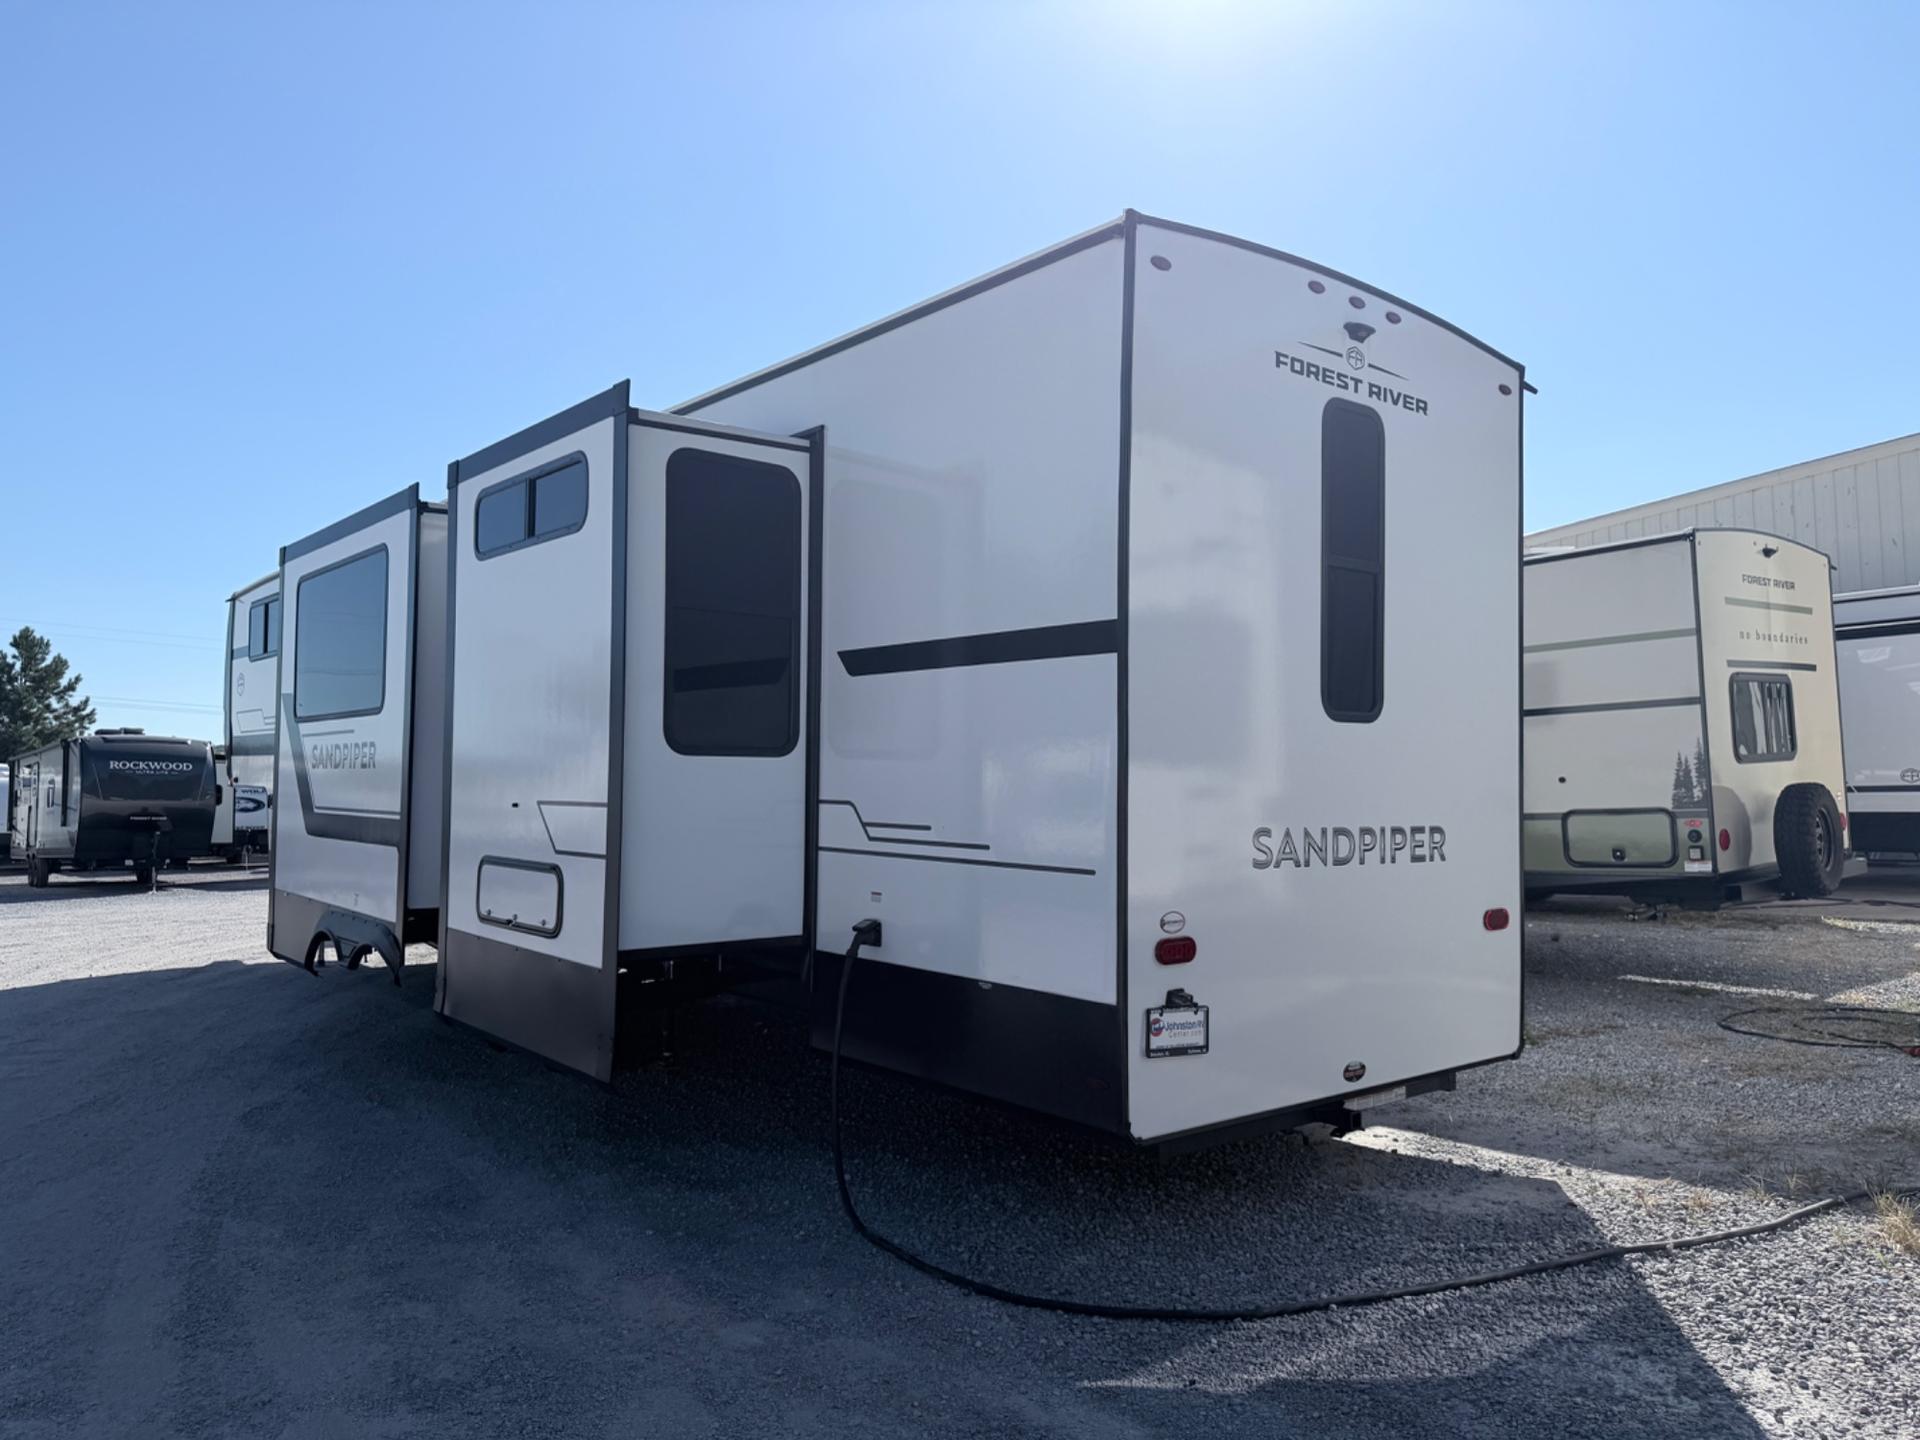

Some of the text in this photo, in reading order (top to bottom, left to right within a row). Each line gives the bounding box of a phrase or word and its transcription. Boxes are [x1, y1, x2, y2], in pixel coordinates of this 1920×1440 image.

[1274, 351, 1428, 416] FOREST RIVER
[1742, 574, 1796, 590] FOREST RIVER
[1739, 628, 1808, 644] no boundaries
[109, 760, 193, 771] ROCKWOOD
[312, 741, 376, 769] SANDPIPER
[1252, 825, 1446, 870] SANDPIPER
